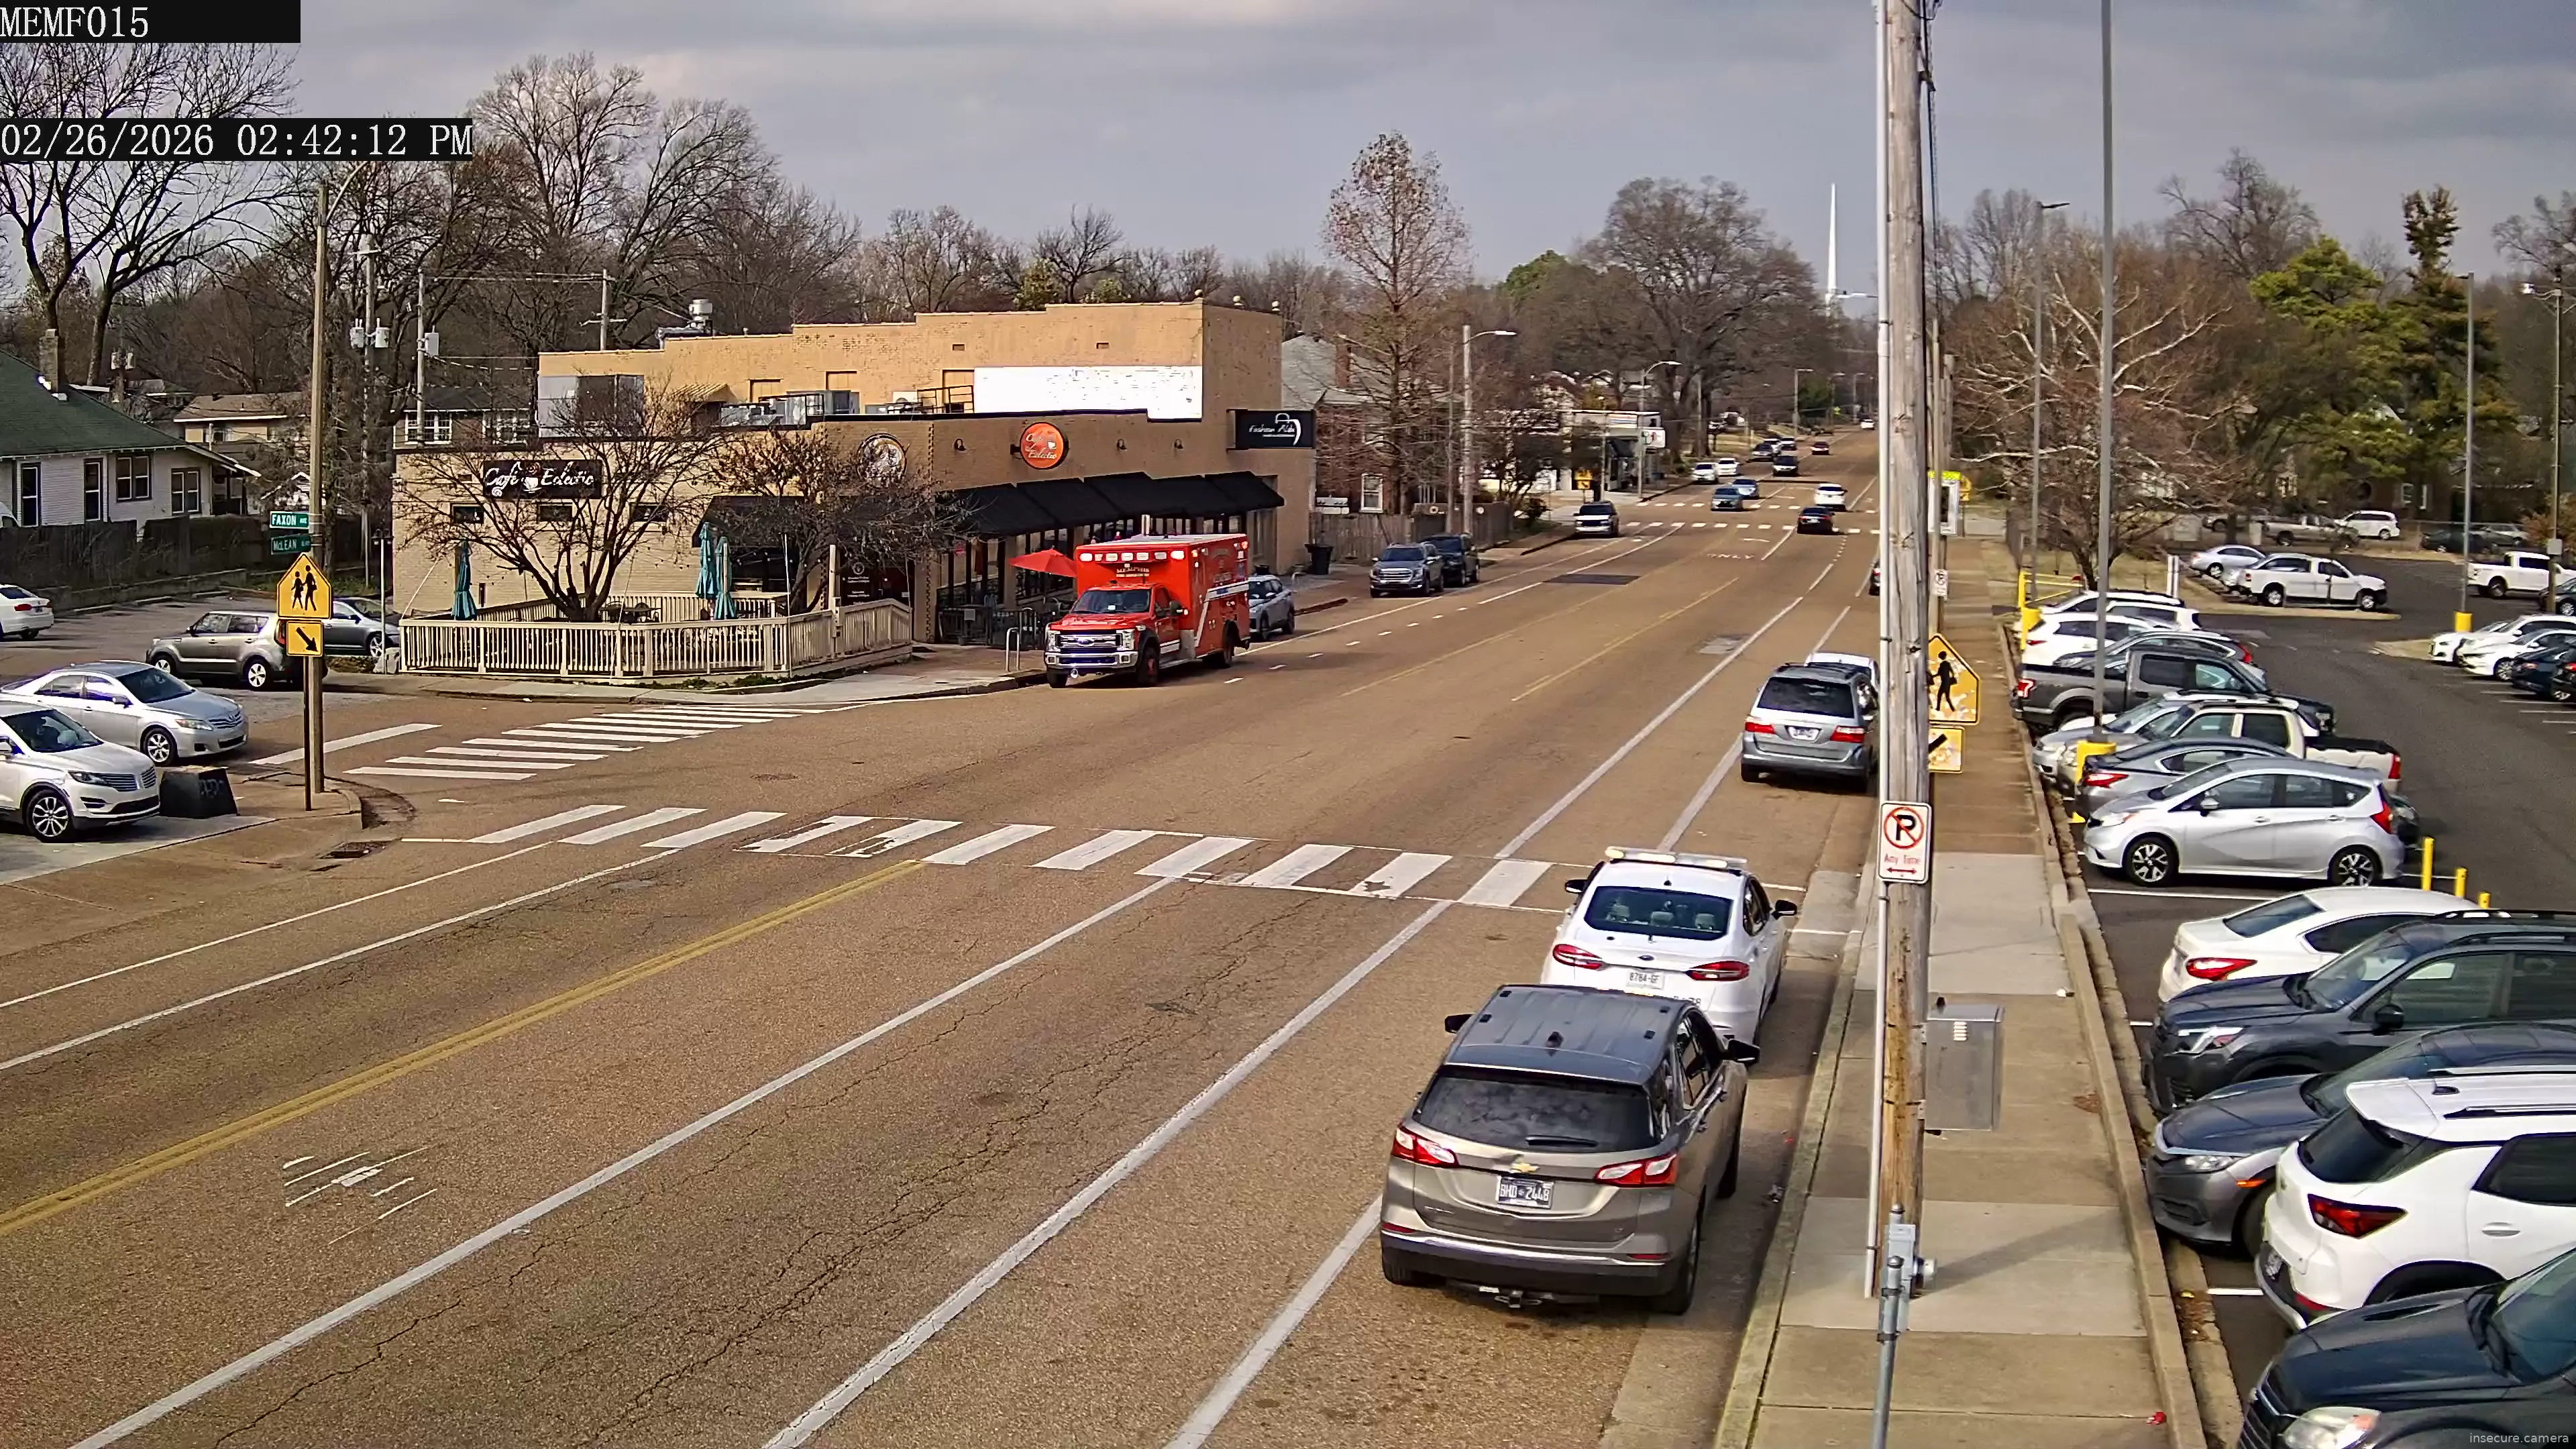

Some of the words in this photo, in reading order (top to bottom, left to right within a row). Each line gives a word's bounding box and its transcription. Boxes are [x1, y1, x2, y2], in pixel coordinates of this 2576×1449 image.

[272, 515, 297, 526] FAXON
[273, 539, 297, 551] McLEAN
[1884, 853, 1898, 865] Any
